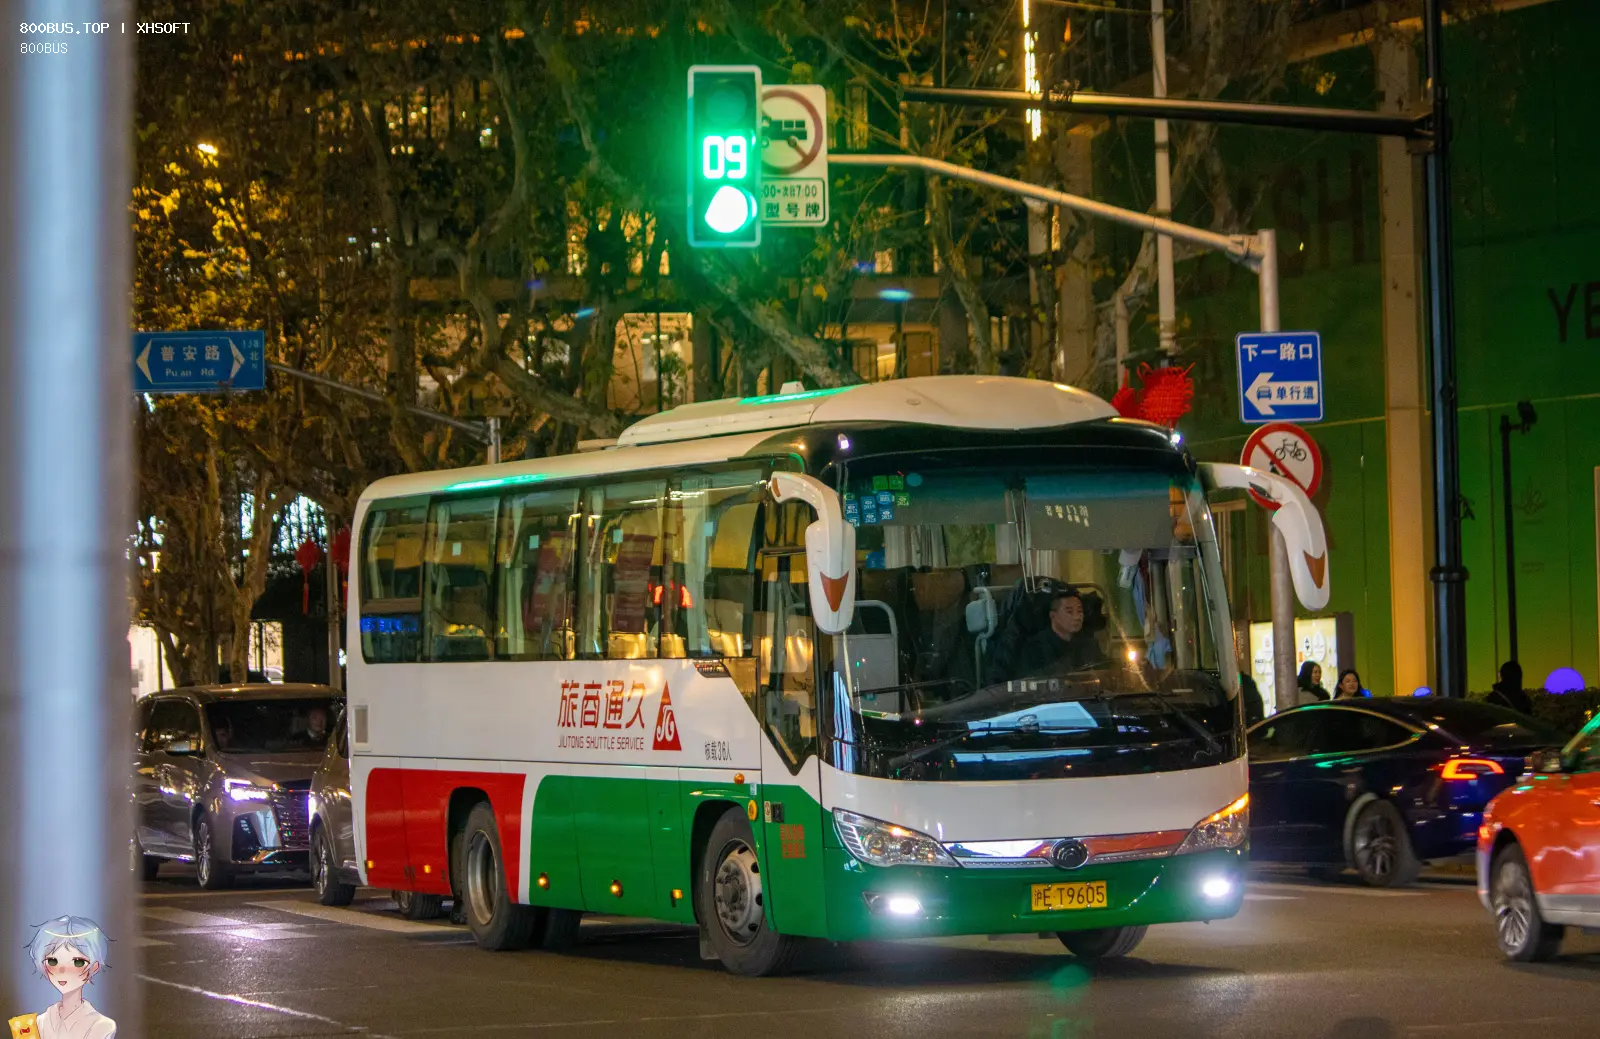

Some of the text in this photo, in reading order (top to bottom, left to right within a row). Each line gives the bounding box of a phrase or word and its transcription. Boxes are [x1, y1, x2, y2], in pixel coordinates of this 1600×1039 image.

[702, 135, 748, 179] 09
[160, 345, 221, 361] 普安路
[1242, 342, 1313, 362] 下一路口
[1276, 386, 1315, 400] 单行道
[586, 735, 615, 749] SHUTTLE
[616, 736, 644, 750] SERVICE
